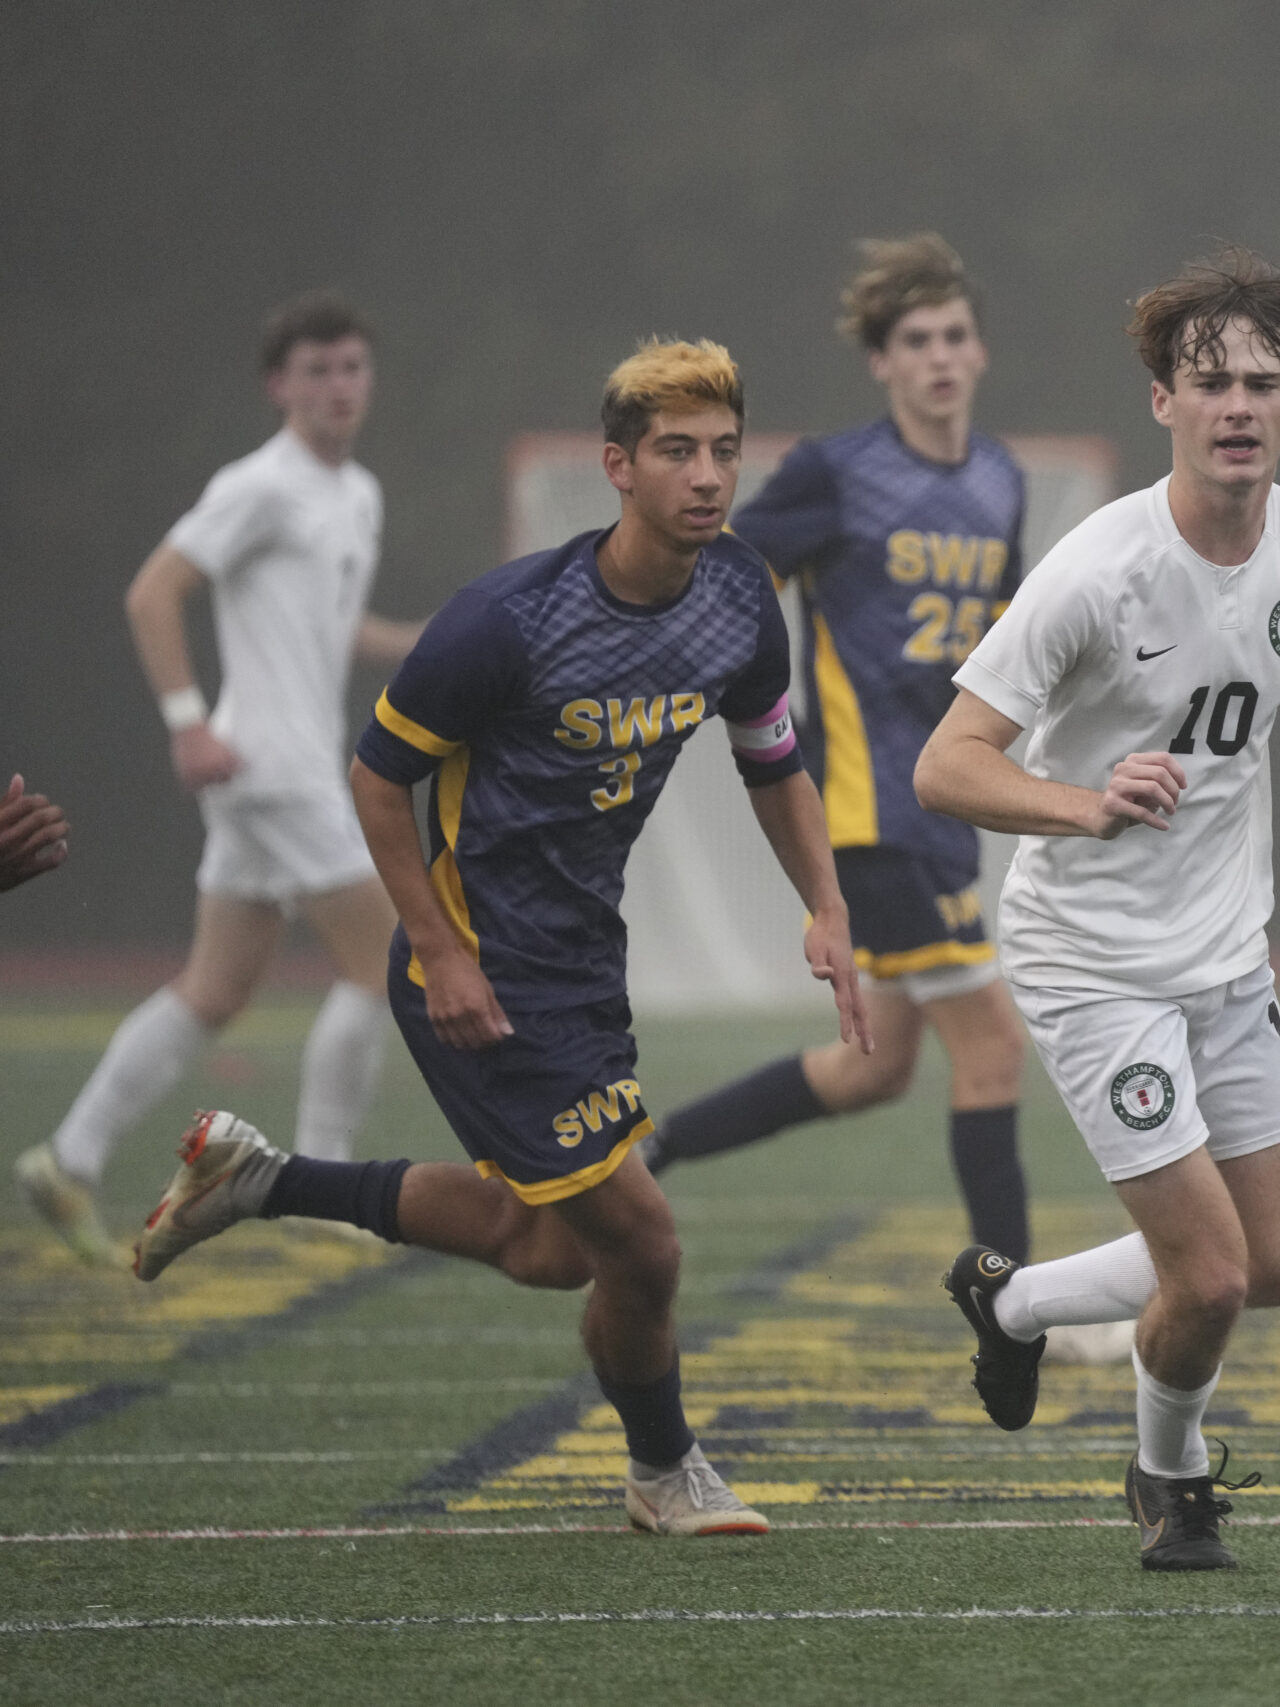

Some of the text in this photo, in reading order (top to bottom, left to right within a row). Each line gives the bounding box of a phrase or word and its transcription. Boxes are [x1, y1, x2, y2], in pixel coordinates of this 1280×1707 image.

[903, 591, 985, 664] 25
[554, 691, 706, 749] SWR
[1168, 681, 1259, 757] 10
[590, 751, 642, 812] 3
[552, 1079, 641, 1148] SWR
[1112, 1065, 1171, 1105] WESTHAMPTON
[1126, 1116, 1159, 1129] BEACH
